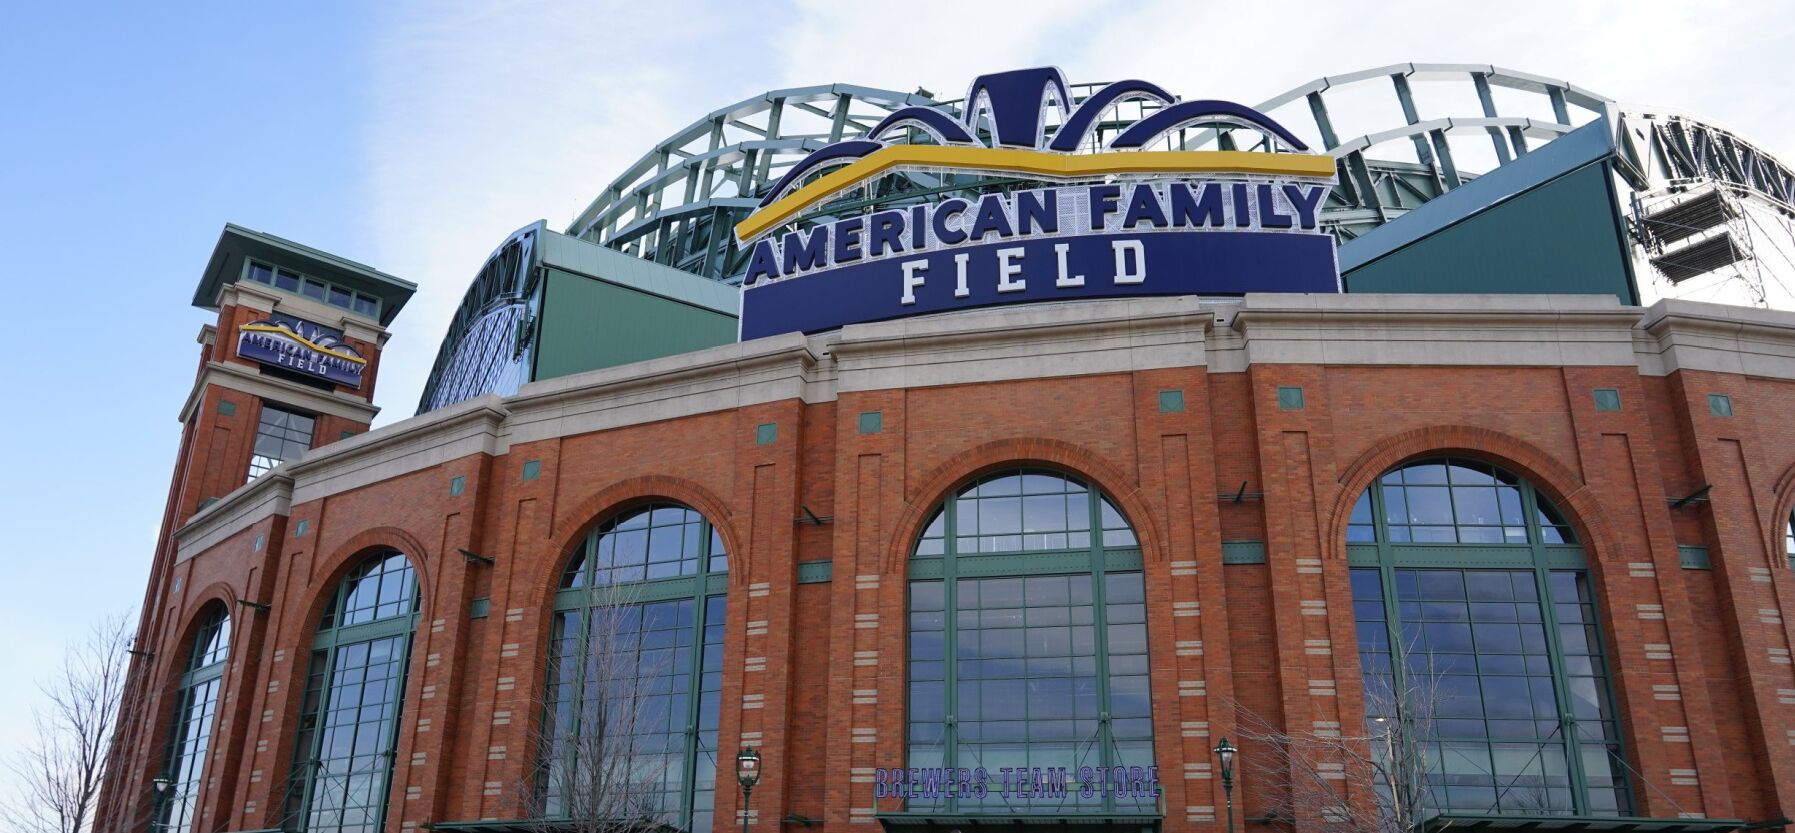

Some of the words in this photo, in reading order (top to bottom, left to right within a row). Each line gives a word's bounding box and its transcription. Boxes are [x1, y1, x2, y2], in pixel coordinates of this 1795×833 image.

[742, 189, 1058, 285] AMERICAN
[1089, 183, 1325, 230] FAMILY
[901, 239, 1147, 305] FIELD
[243, 333, 312, 363] AMERICAN
[319, 354, 363, 375] FAMILY
[277, 354, 327, 375] FIELD
[875, 767, 988, 798] BREWERS
[1000, 766, 1066, 798] TEAM
[1079, 766, 1160, 797] STORE
